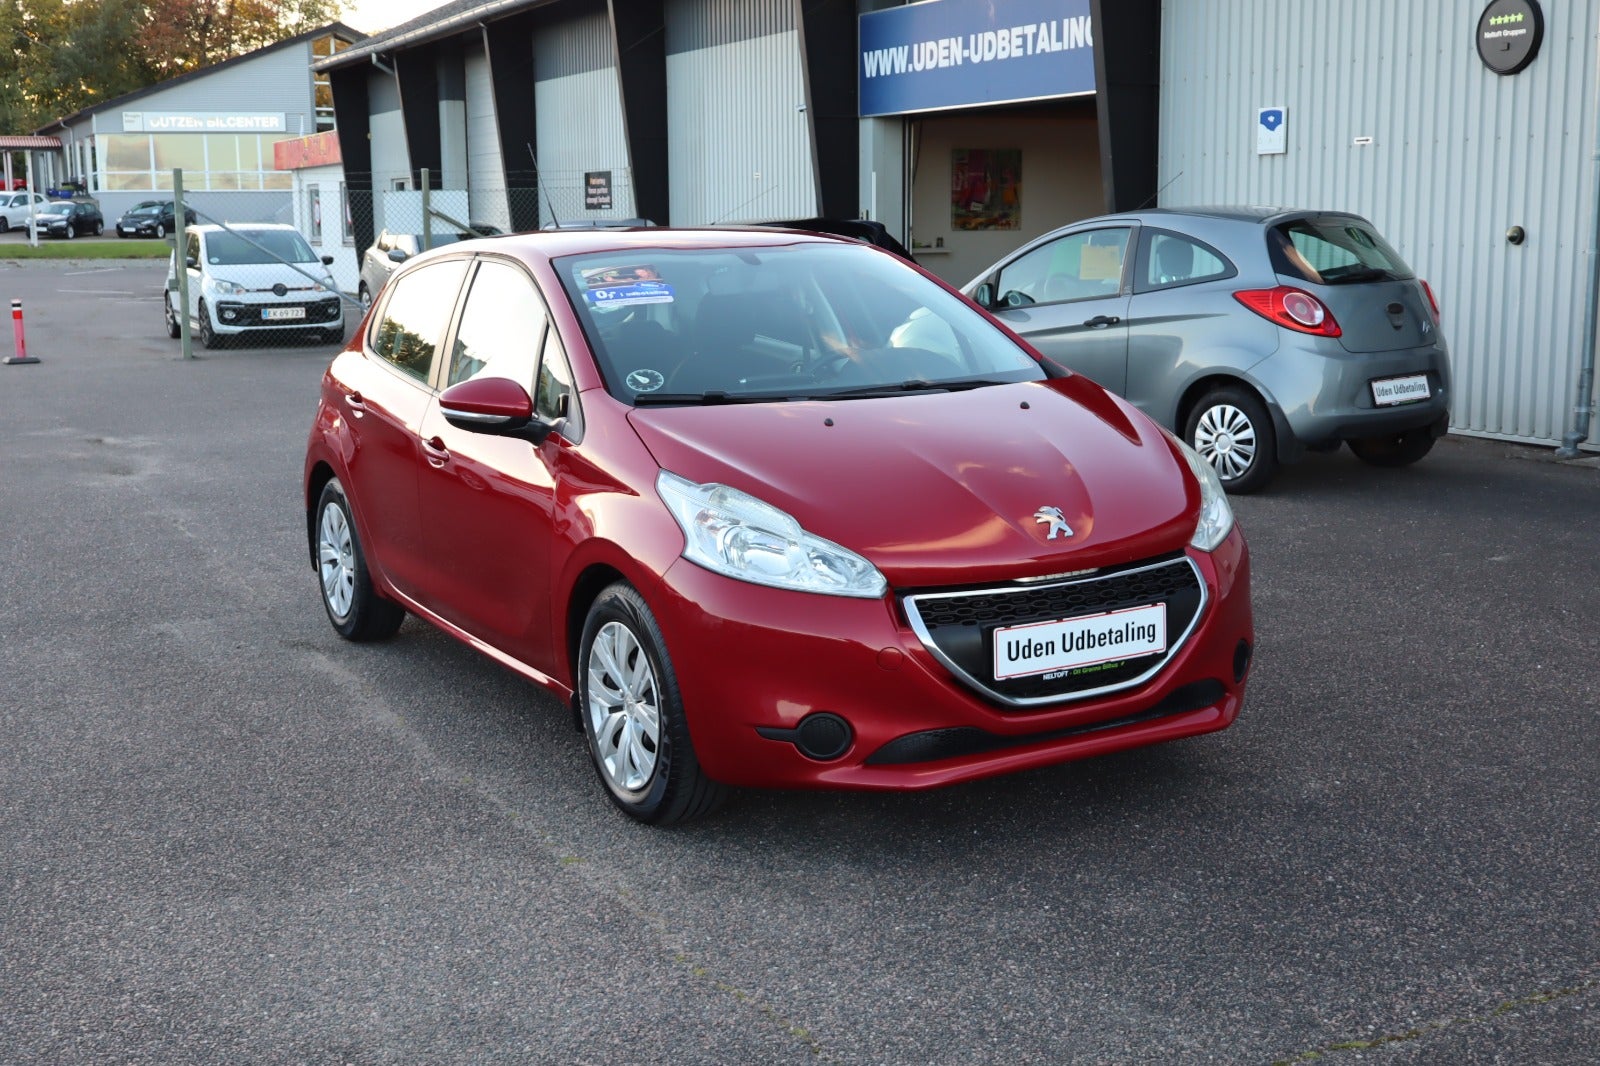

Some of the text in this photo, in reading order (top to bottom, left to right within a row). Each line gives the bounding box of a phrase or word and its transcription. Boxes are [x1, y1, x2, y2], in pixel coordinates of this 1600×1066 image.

[1376, 381, 1427, 396] Uden Udbetaling
[1007, 621, 1156, 661] Uden Udbetaling
[1042, 670, 1069, 680] NELTOFT
